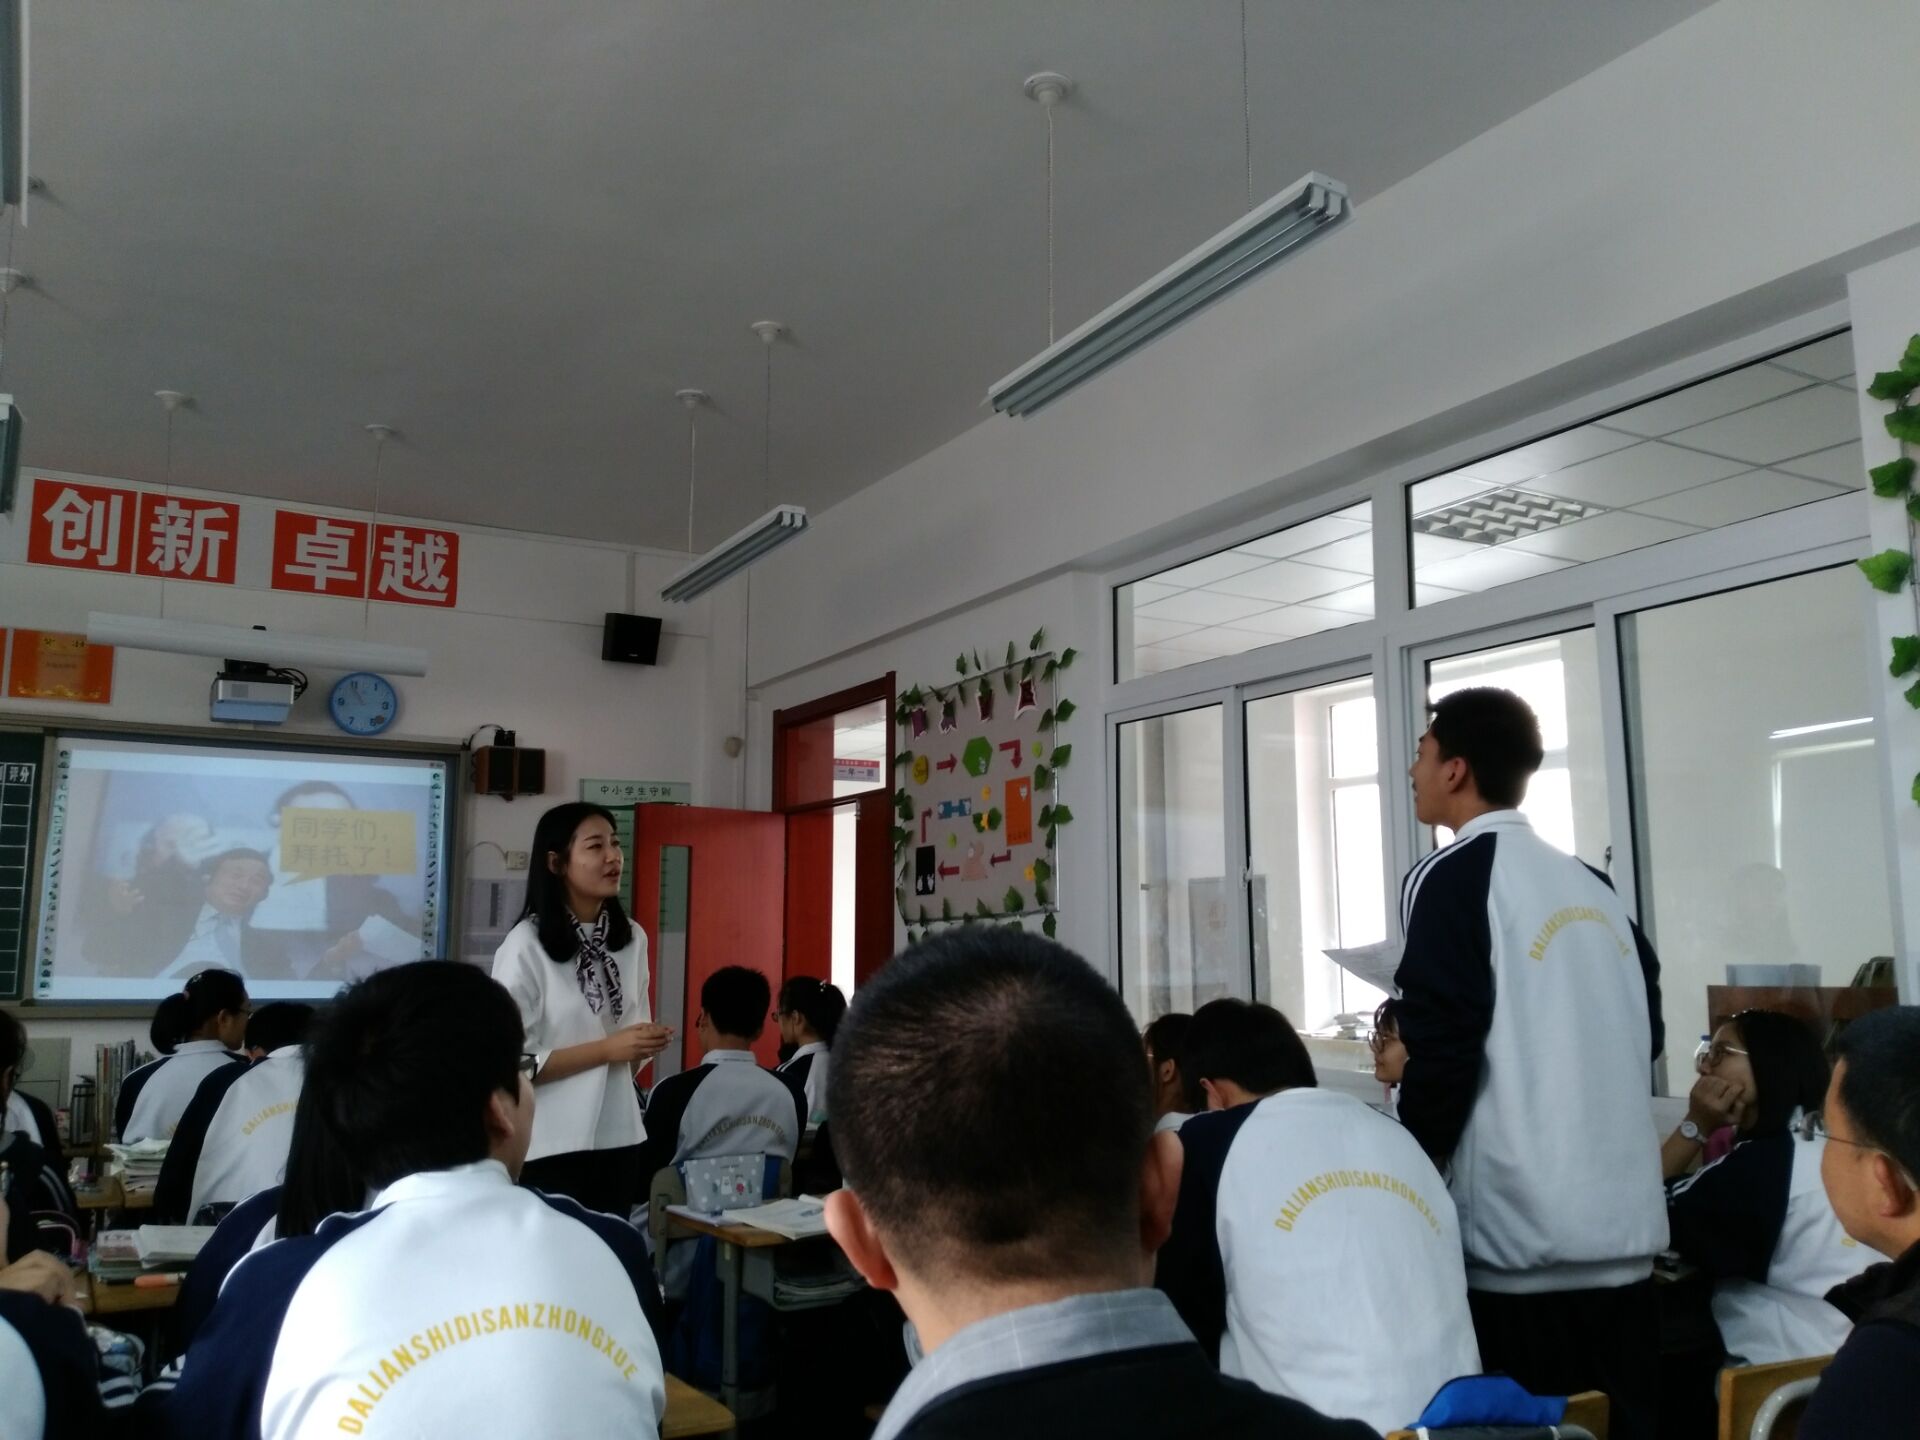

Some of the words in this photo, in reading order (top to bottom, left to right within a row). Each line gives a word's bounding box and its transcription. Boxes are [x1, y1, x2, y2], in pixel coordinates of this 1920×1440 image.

[42, 487, 230, 578] 创新
[284, 519, 450, 602] 卓越
[338, 1303, 638, 1435] DALIANSHIDISANZHONGXUE
